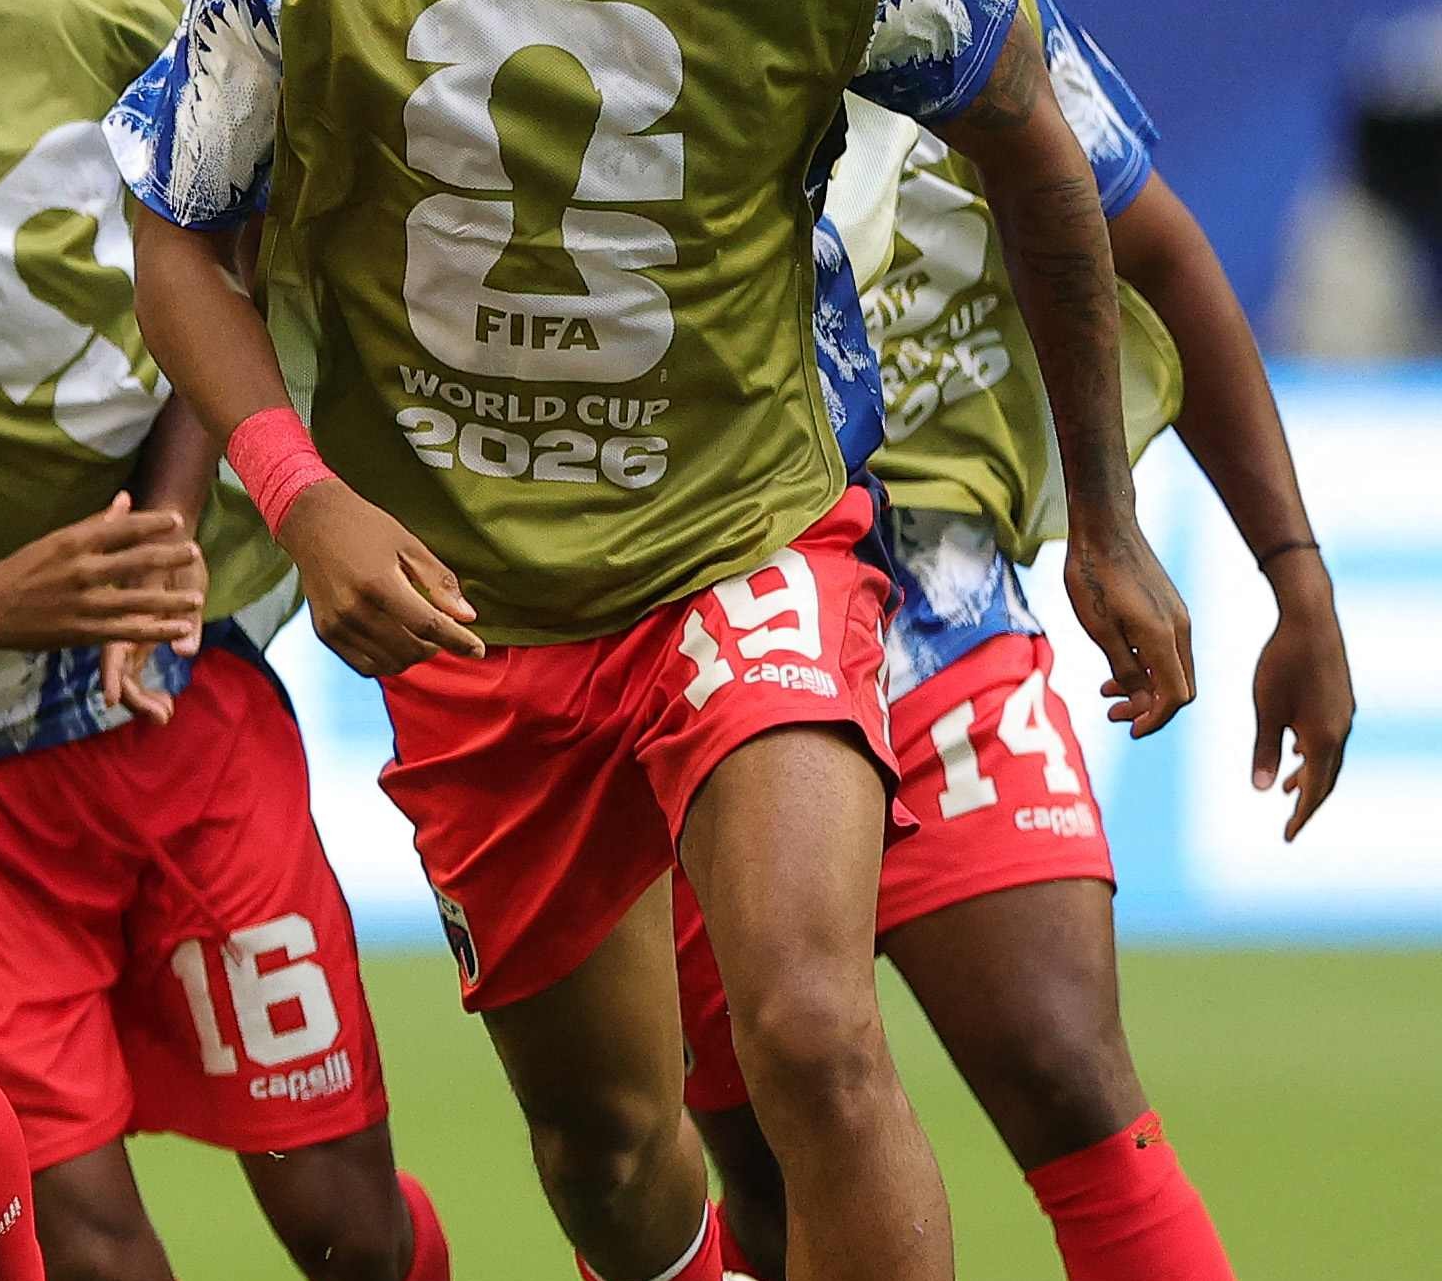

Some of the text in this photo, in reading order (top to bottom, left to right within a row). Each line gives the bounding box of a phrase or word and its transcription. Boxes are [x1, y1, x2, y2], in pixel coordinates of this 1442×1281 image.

[475, 302, 600, 351] FIFA
[395, 406, 669, 489] 2026
[399, 365, 670, 431] WORLD CUP
[678, 547, 822, 711] 19
[930, 669, 1081, 822] 14
[171, 913, 342, 1077] 16
